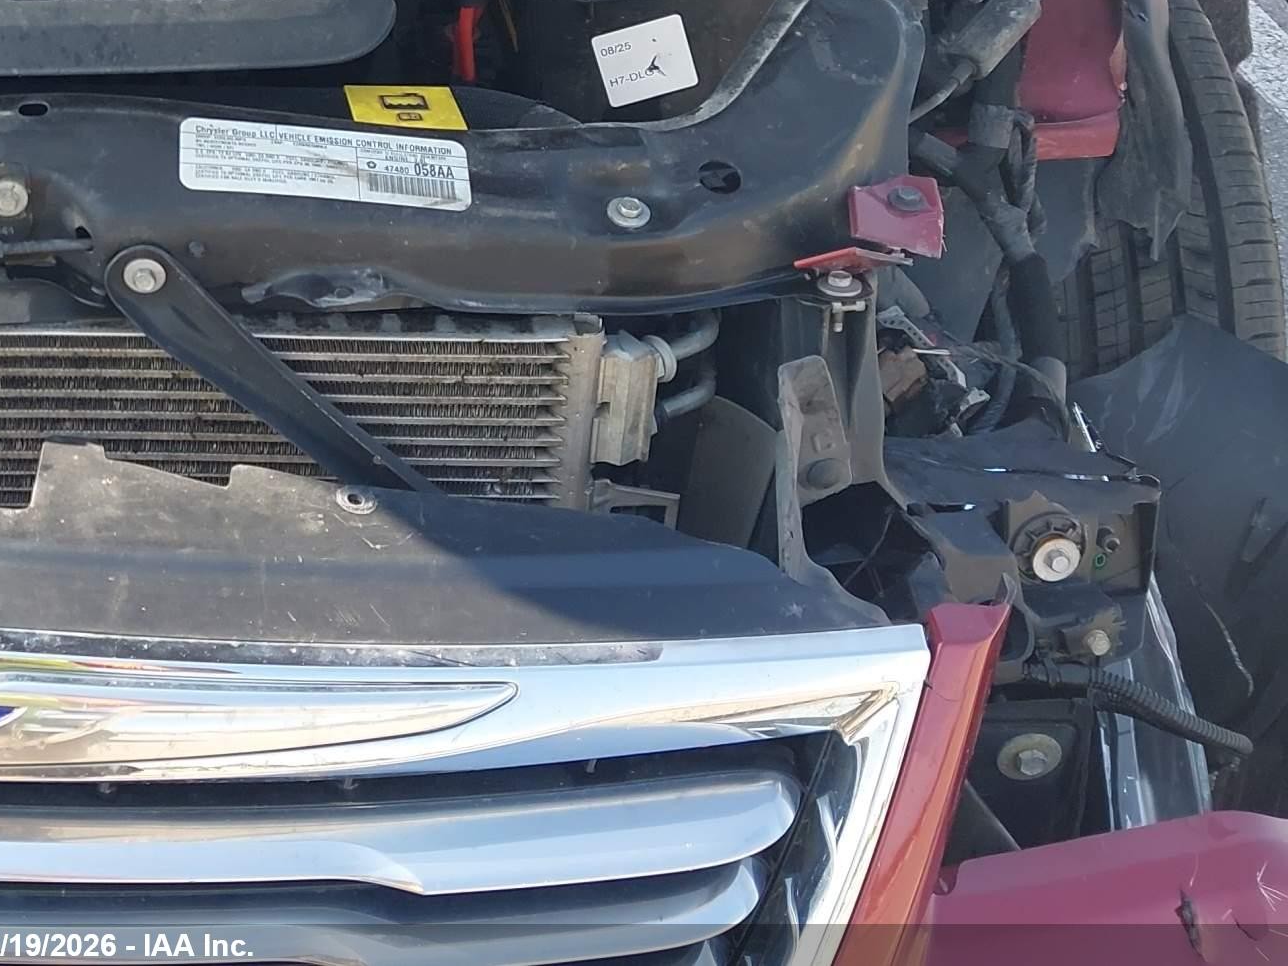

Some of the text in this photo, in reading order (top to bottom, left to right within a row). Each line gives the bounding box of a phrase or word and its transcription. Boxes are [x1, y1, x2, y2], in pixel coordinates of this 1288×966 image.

[600, 41, 632, 57] 08/25
[195, 124, 229, 135] Chrysler
[232, 128, 257, 139] Group
[260, 130, 276, 139] LLC
[279, 132, 311, 142] VEHICLE
[314, 135, 353, 147] EMISSION
[356, 139, 393, 151] CONTROL
[396, 142, 452, 155] INFORMATION
[414, 162, 455, 179] 058AA
